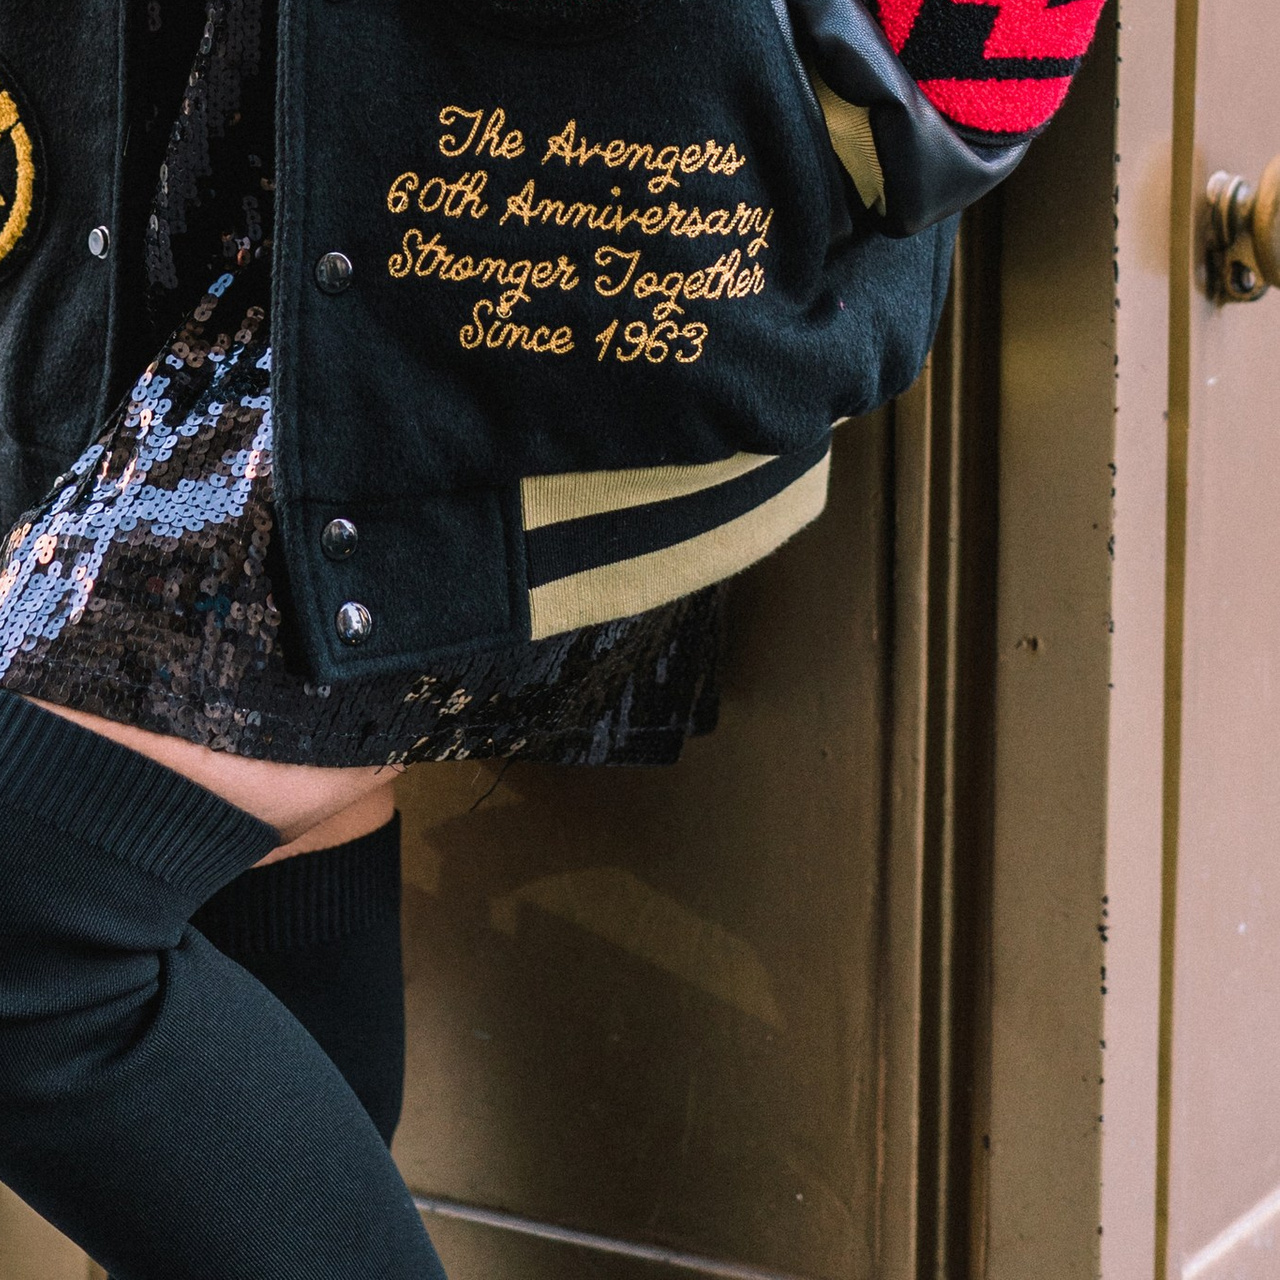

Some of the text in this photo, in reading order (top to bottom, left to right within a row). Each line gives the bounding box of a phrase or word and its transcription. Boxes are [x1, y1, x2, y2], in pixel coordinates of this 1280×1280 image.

[438, 105, 746, 194] The Avengers
[386, 169, 774, 258] 60th Anniversary
[388, 228, 765, 321] Stronger Together
[459, 298, 709, 364] Since 1963
